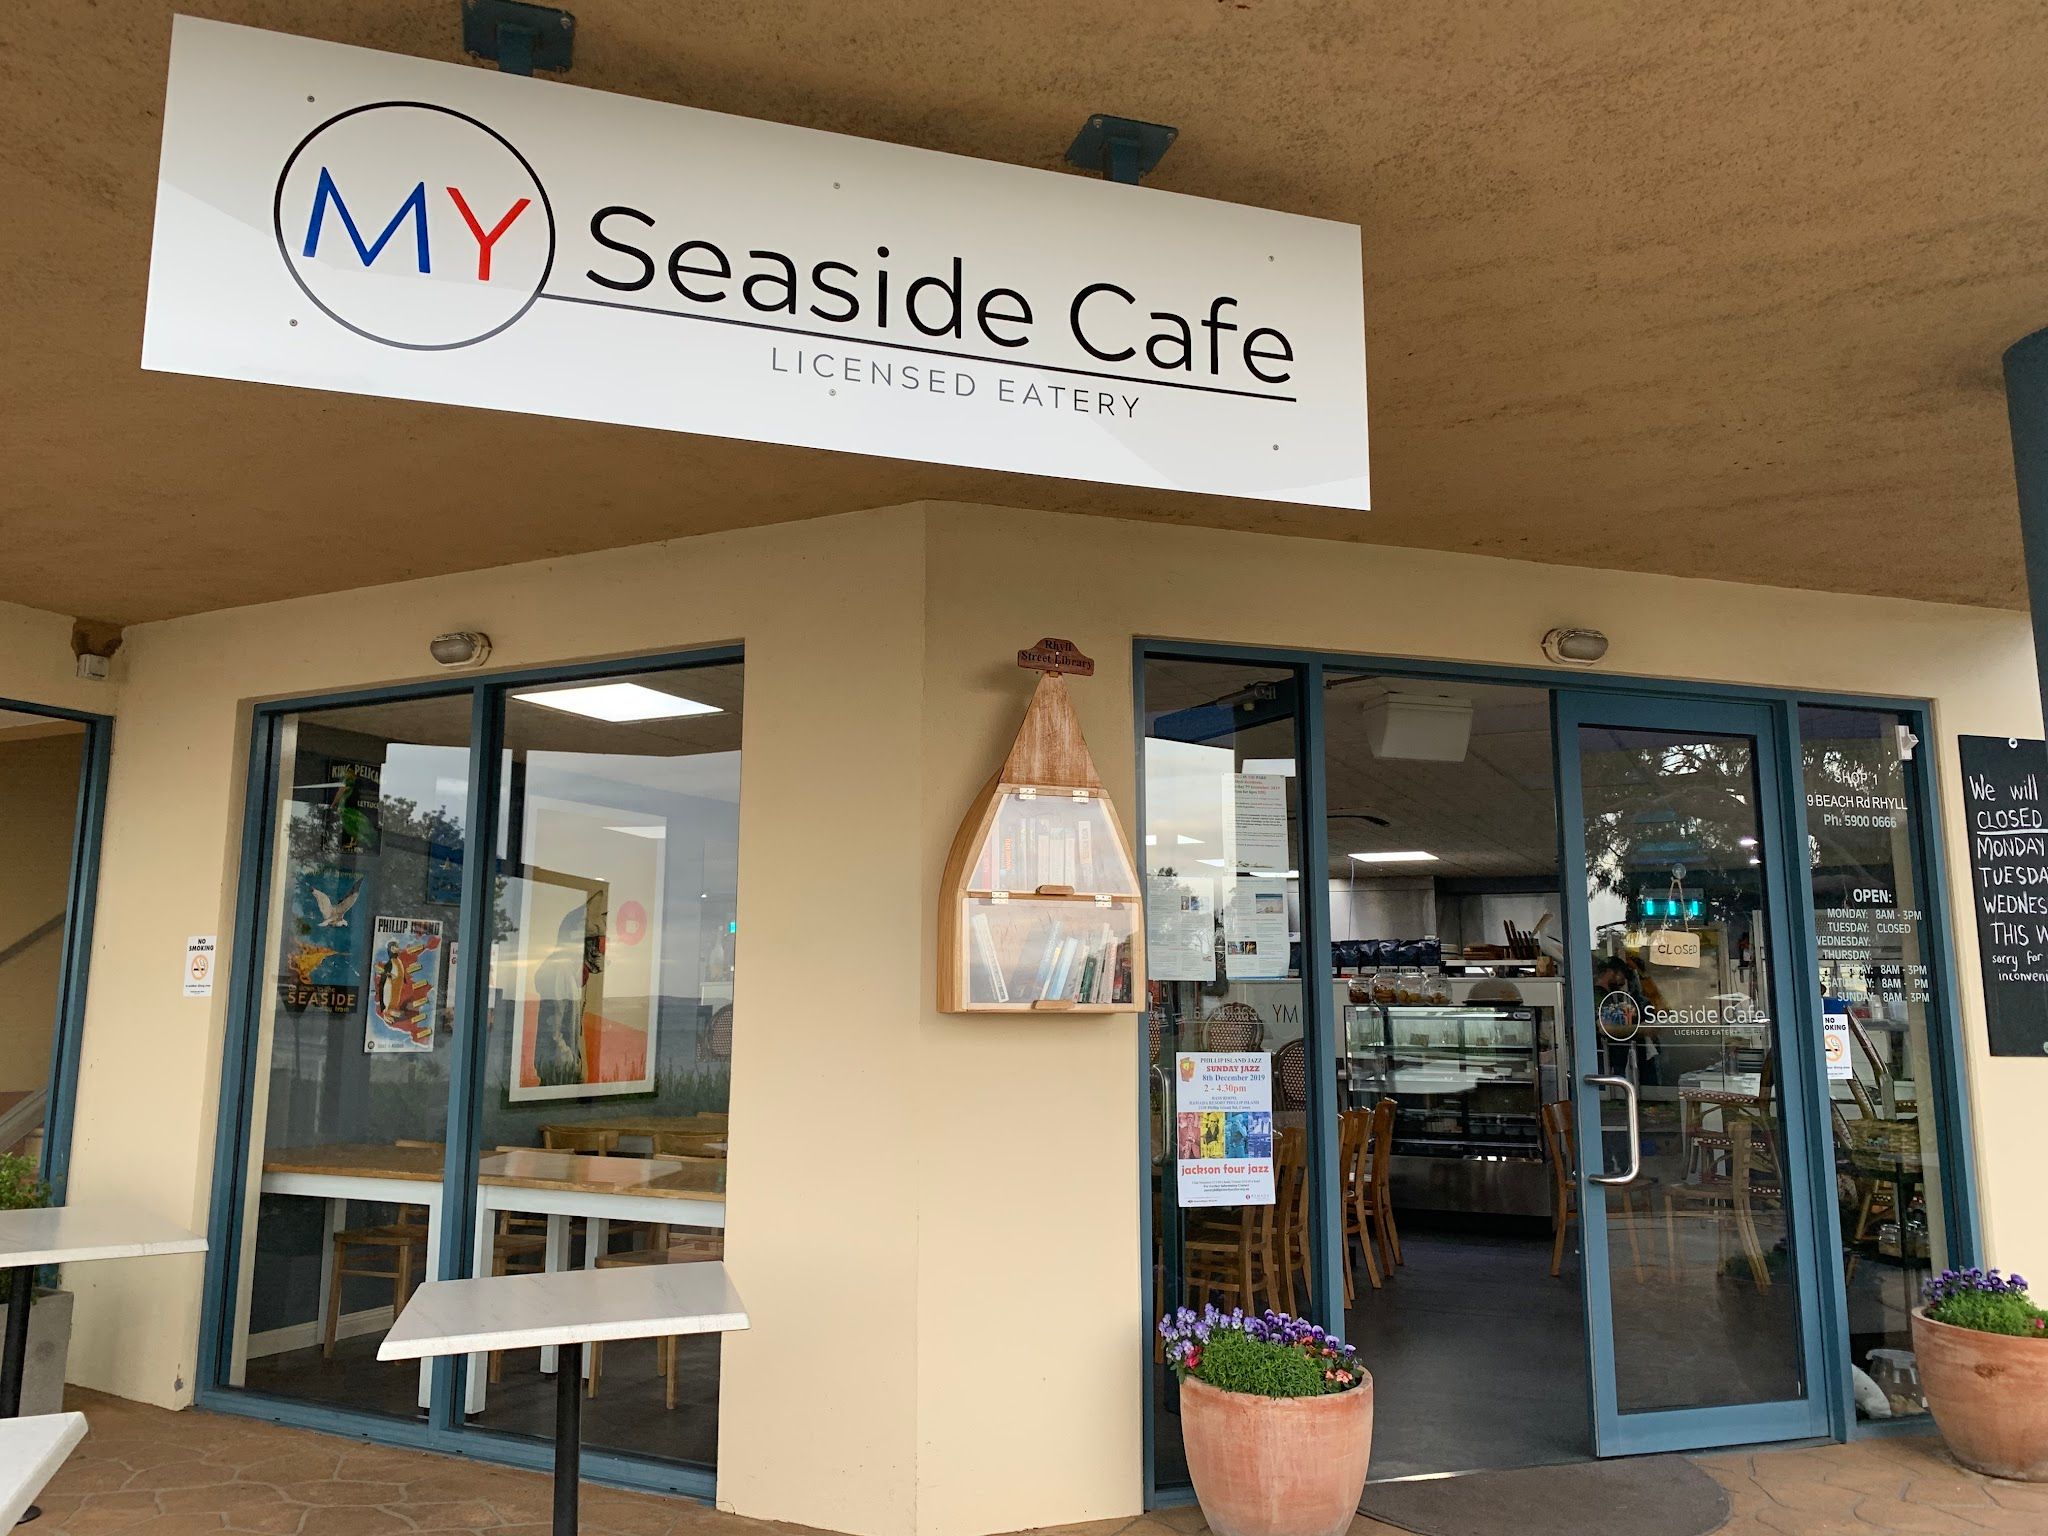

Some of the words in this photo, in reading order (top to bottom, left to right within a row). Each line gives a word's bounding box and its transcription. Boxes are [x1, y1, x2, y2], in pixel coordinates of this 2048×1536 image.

[303, 166, 531, 281] MY
[585, 205, 1034, 348] Seaside
[1069, 282, 1295, 384] Cafe
[772, 346, 976, 398] LICENSED
[999, 379, 1141, 420] EATERY
[1045, 640, 1072, 652] Rhyll
[1021, 651, 1051, 663] Street
[1055, 653, 1092, 670] Library
[354, 764, 380, 785] PELICA
[1834, 771, 1868, 785] SHOP
[1872, 773, 1878, 785] 1
[1969, 773, 1996, 801] We
[2009, 773, 2039, 801] will
[1806, 794, 1814, 807] 9
[1816, 794, 1854, 808] BEACH
[1856, 796, 1870, 808] Rd
[1872, 796, 1908, 810] RHYLL
[1823, 813, 1842, 826] Ph:
[1845, 814, 1869, 827] 5900
[1872, 815, 1897, 828] 0666
[1977, 807, 2042, 829] CLOSED
[1977, 836, 2045, 861] MONDAY
[1978, 865, 2048, 888] TUESDA
[1853, 888, 1892, 903] OPEN:
[1827, 908, 1869, 919] MONDAY:
[1875, 909, 1895, 920] 8AM
[1902, 910, 1922, 921] 3PM
[377, 918, 408, 933] PHILLIP
[411, 920, 440, 936] IND
[1828, 922, 1870, 933] TUESDAY:
[1876, 923, 1911, 934] CLOSED
[1990, 922, 2029, 946] THIS
[1657, 943, 1698, 955] CLOSED
[1822, 949, 1873, 960] THURSDAY:
[1992, 954, 2018, 972] sorry
[2026, 950, 2043, 965] for
[1880, 964, 1900, 975] 8AM
[1908, 965, 1927, 975] 3PM
[1826, 977, 1875, 989] SATUAY:
[1881, 978, 1902, 989] 8AM
[287, 991, 356, 1006] SEASIDE
[1883, 992, 1902, 1002] 8AM
[1910, 993, 1930, 1003] 3PM
[1644, 1004, 1718, 1024] Seaside
[1723, 1004, 1766, 1024] Cafe
[1240, 1065, 1260, 1073] JAZZ
[1216, 1084, 1247, 1094] 4.30pm
[1181, 1164, 1220, 1177] jackson
[1223, 1163, 1245, 1174] four
[1248, 1163, 1269, 1175] jazz
